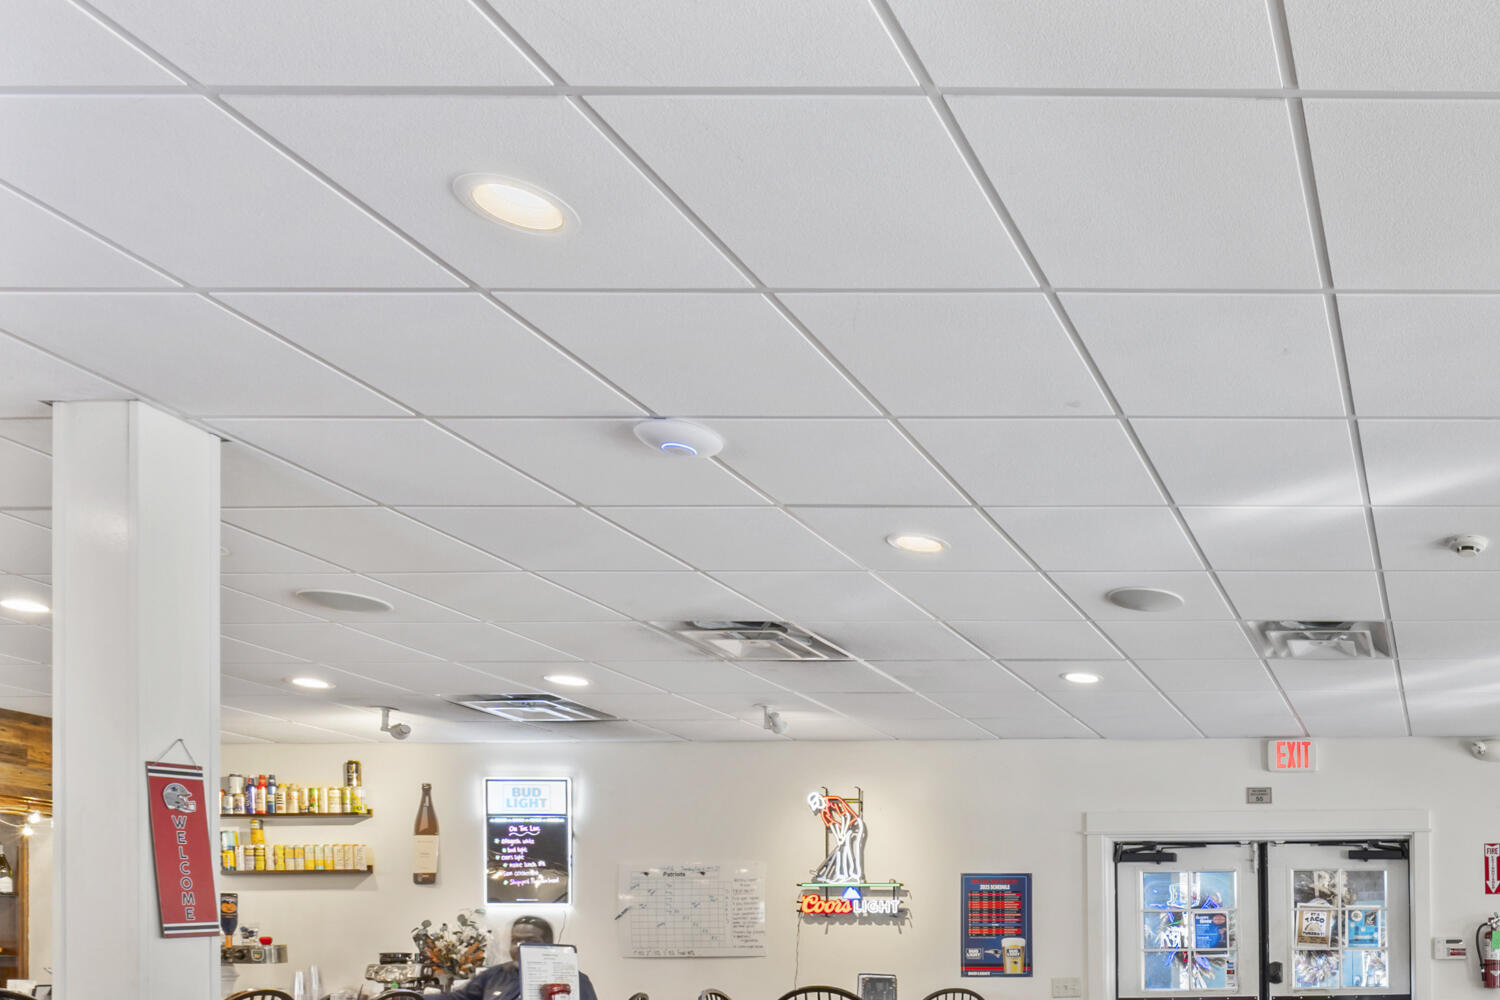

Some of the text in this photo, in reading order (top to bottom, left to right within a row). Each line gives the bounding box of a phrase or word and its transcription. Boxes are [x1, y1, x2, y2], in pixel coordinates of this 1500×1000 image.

[1276, 741, 1311, 769] EXIT
[512, 787, 542, 798] BUD
[506, 798, 548, 809] LIGHT
[1486, 847, 1498, 855] FIRE
[171, 815, 196, 921] WELCOME
[801, 893, 901, 915] Coors LIGHT
[1304, 916, 1325, 924] TACO
